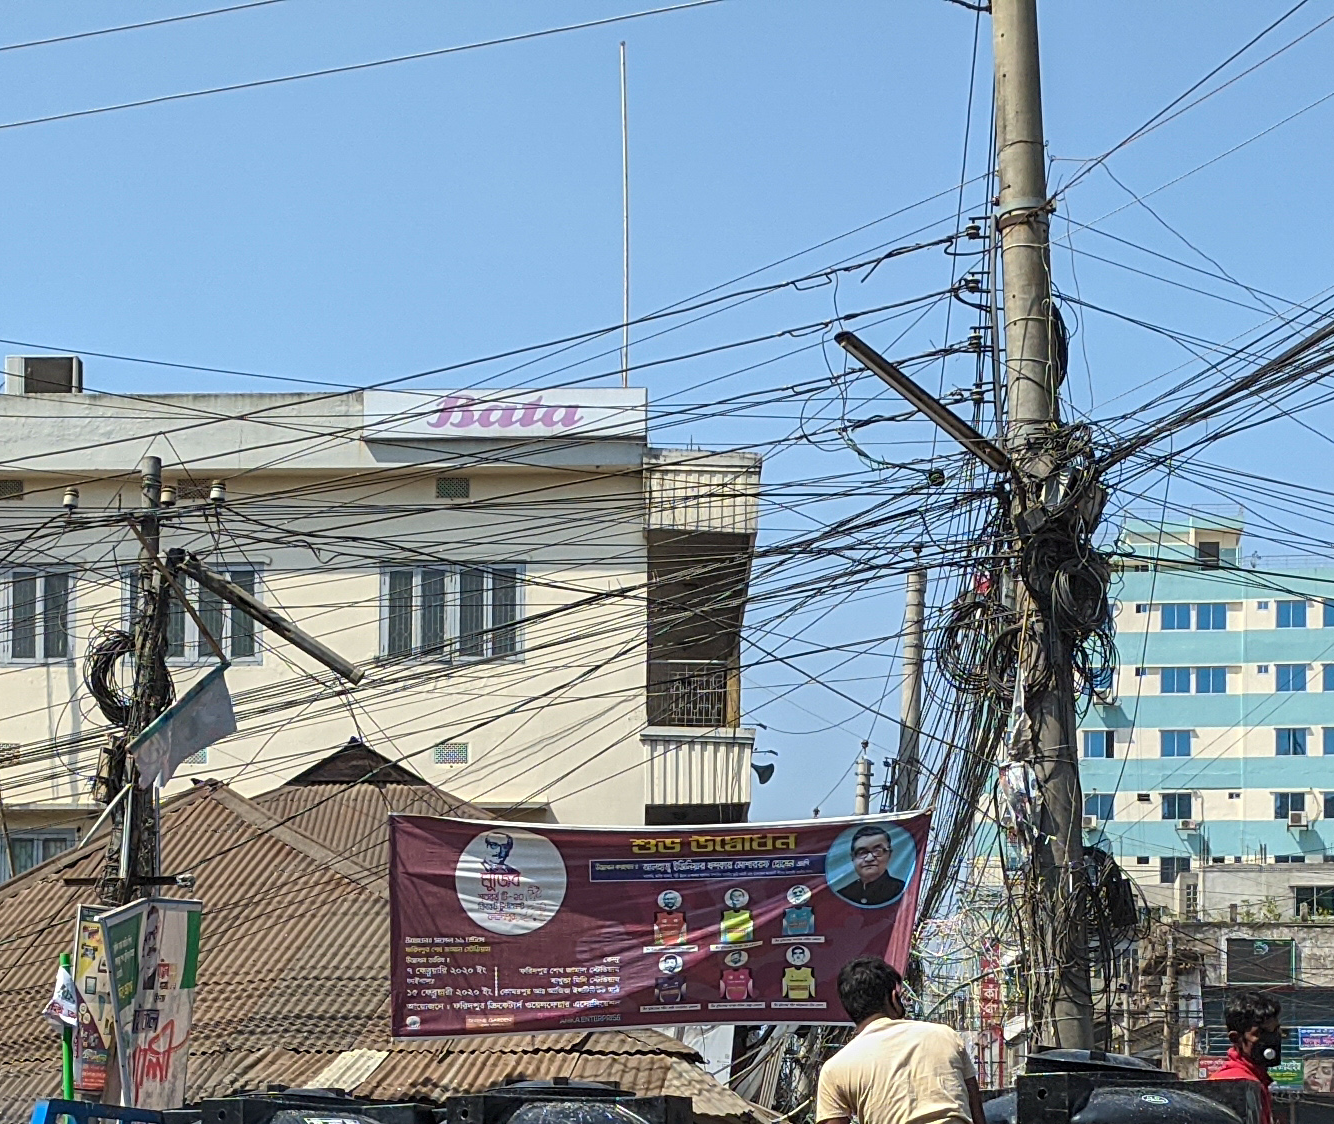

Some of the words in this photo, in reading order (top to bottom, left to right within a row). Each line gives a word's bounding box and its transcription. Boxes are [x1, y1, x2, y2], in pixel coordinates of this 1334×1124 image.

[426, 394, 584, 429] Bata
[629, 838, 683, 855] শুভ
[689, 832, 798, 853] উদ্বোধন
[450, 967, 473, 975] ২০২০
[456, 988, 479, 996] ২০২০
